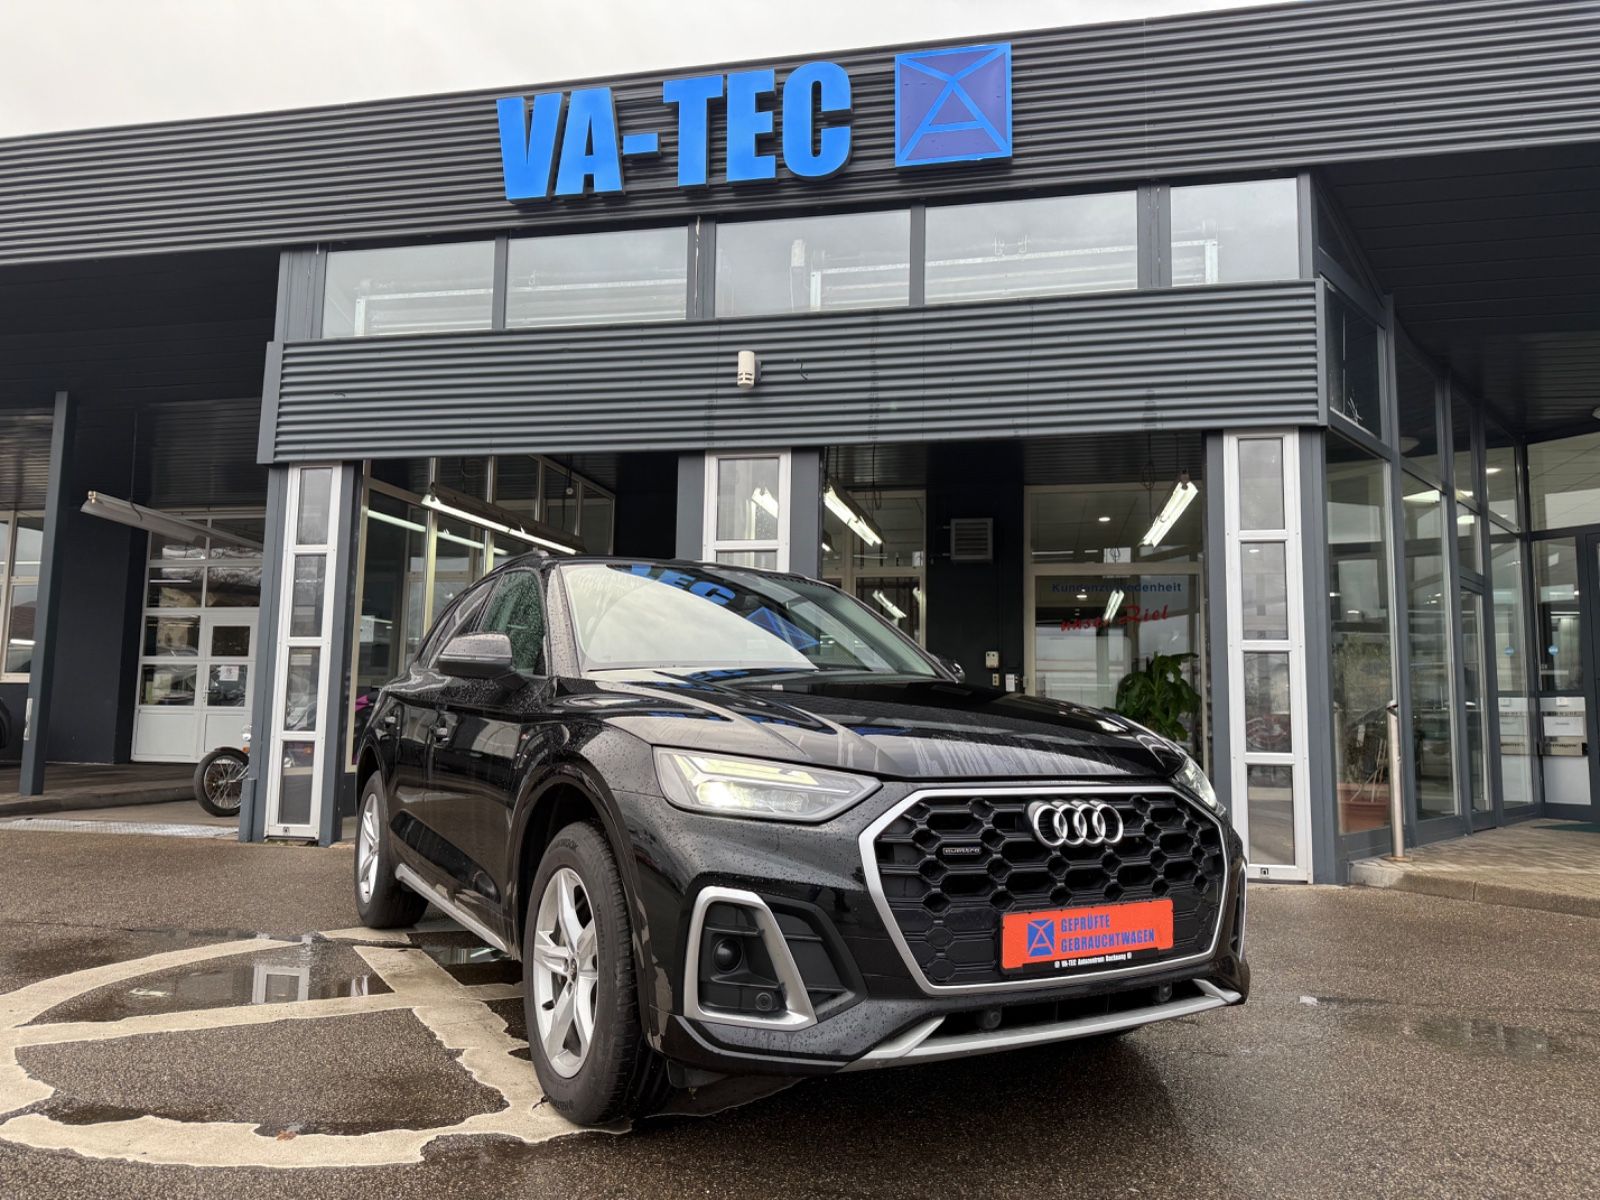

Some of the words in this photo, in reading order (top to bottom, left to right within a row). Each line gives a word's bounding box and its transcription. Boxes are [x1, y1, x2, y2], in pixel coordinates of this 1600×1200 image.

[496, 60, 853, 202] VA-TEC
[1052, 582, 1182, 593] Kundenzuiedenheit
[1060, 617, 1110, 632] unse
[1120, 604, 1169, 626] Ziel
[1060, 913, 1110, 933] GEPRÜFTE
[1060, 928, 1155, 953] GEBRAUCHTWAGEN
